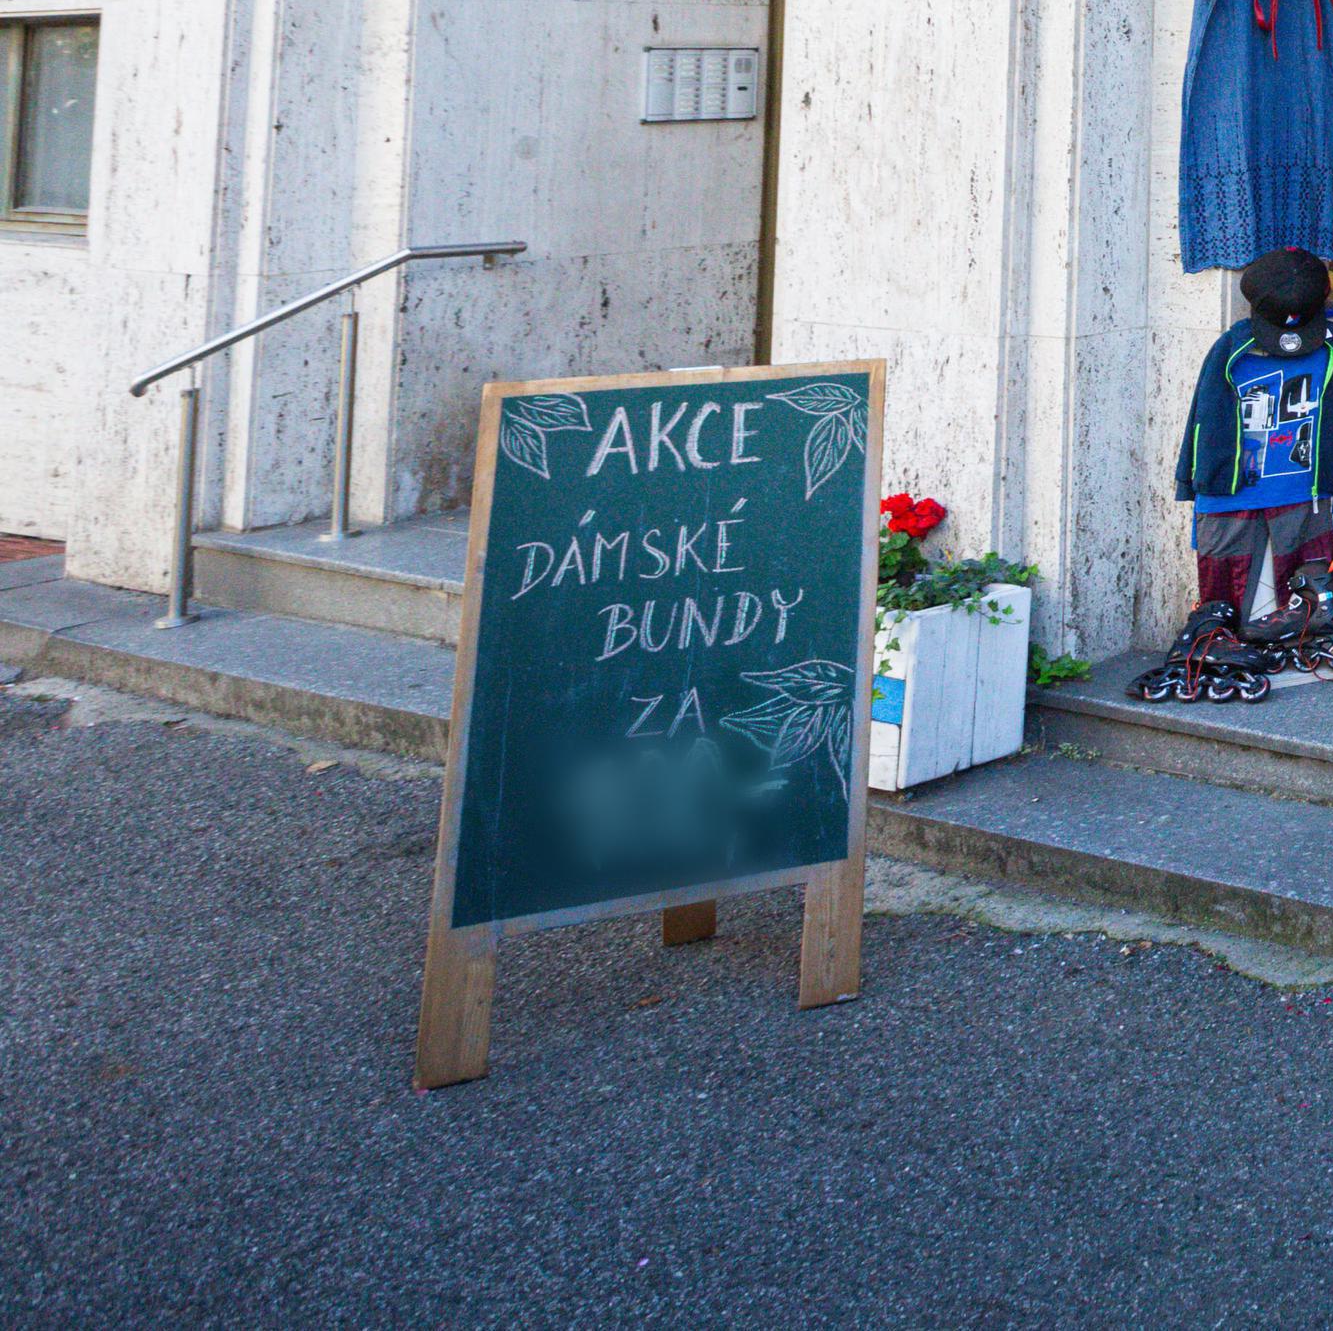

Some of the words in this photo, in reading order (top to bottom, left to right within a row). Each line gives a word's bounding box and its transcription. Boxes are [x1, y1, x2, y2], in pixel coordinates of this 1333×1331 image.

[585, 400, 764, 478] AKCE
[511, 496, 749, 602] DÁMSKÉ
[595, 587, 804, 662] BUNDY
[624, 686, 707, 740] ZA
